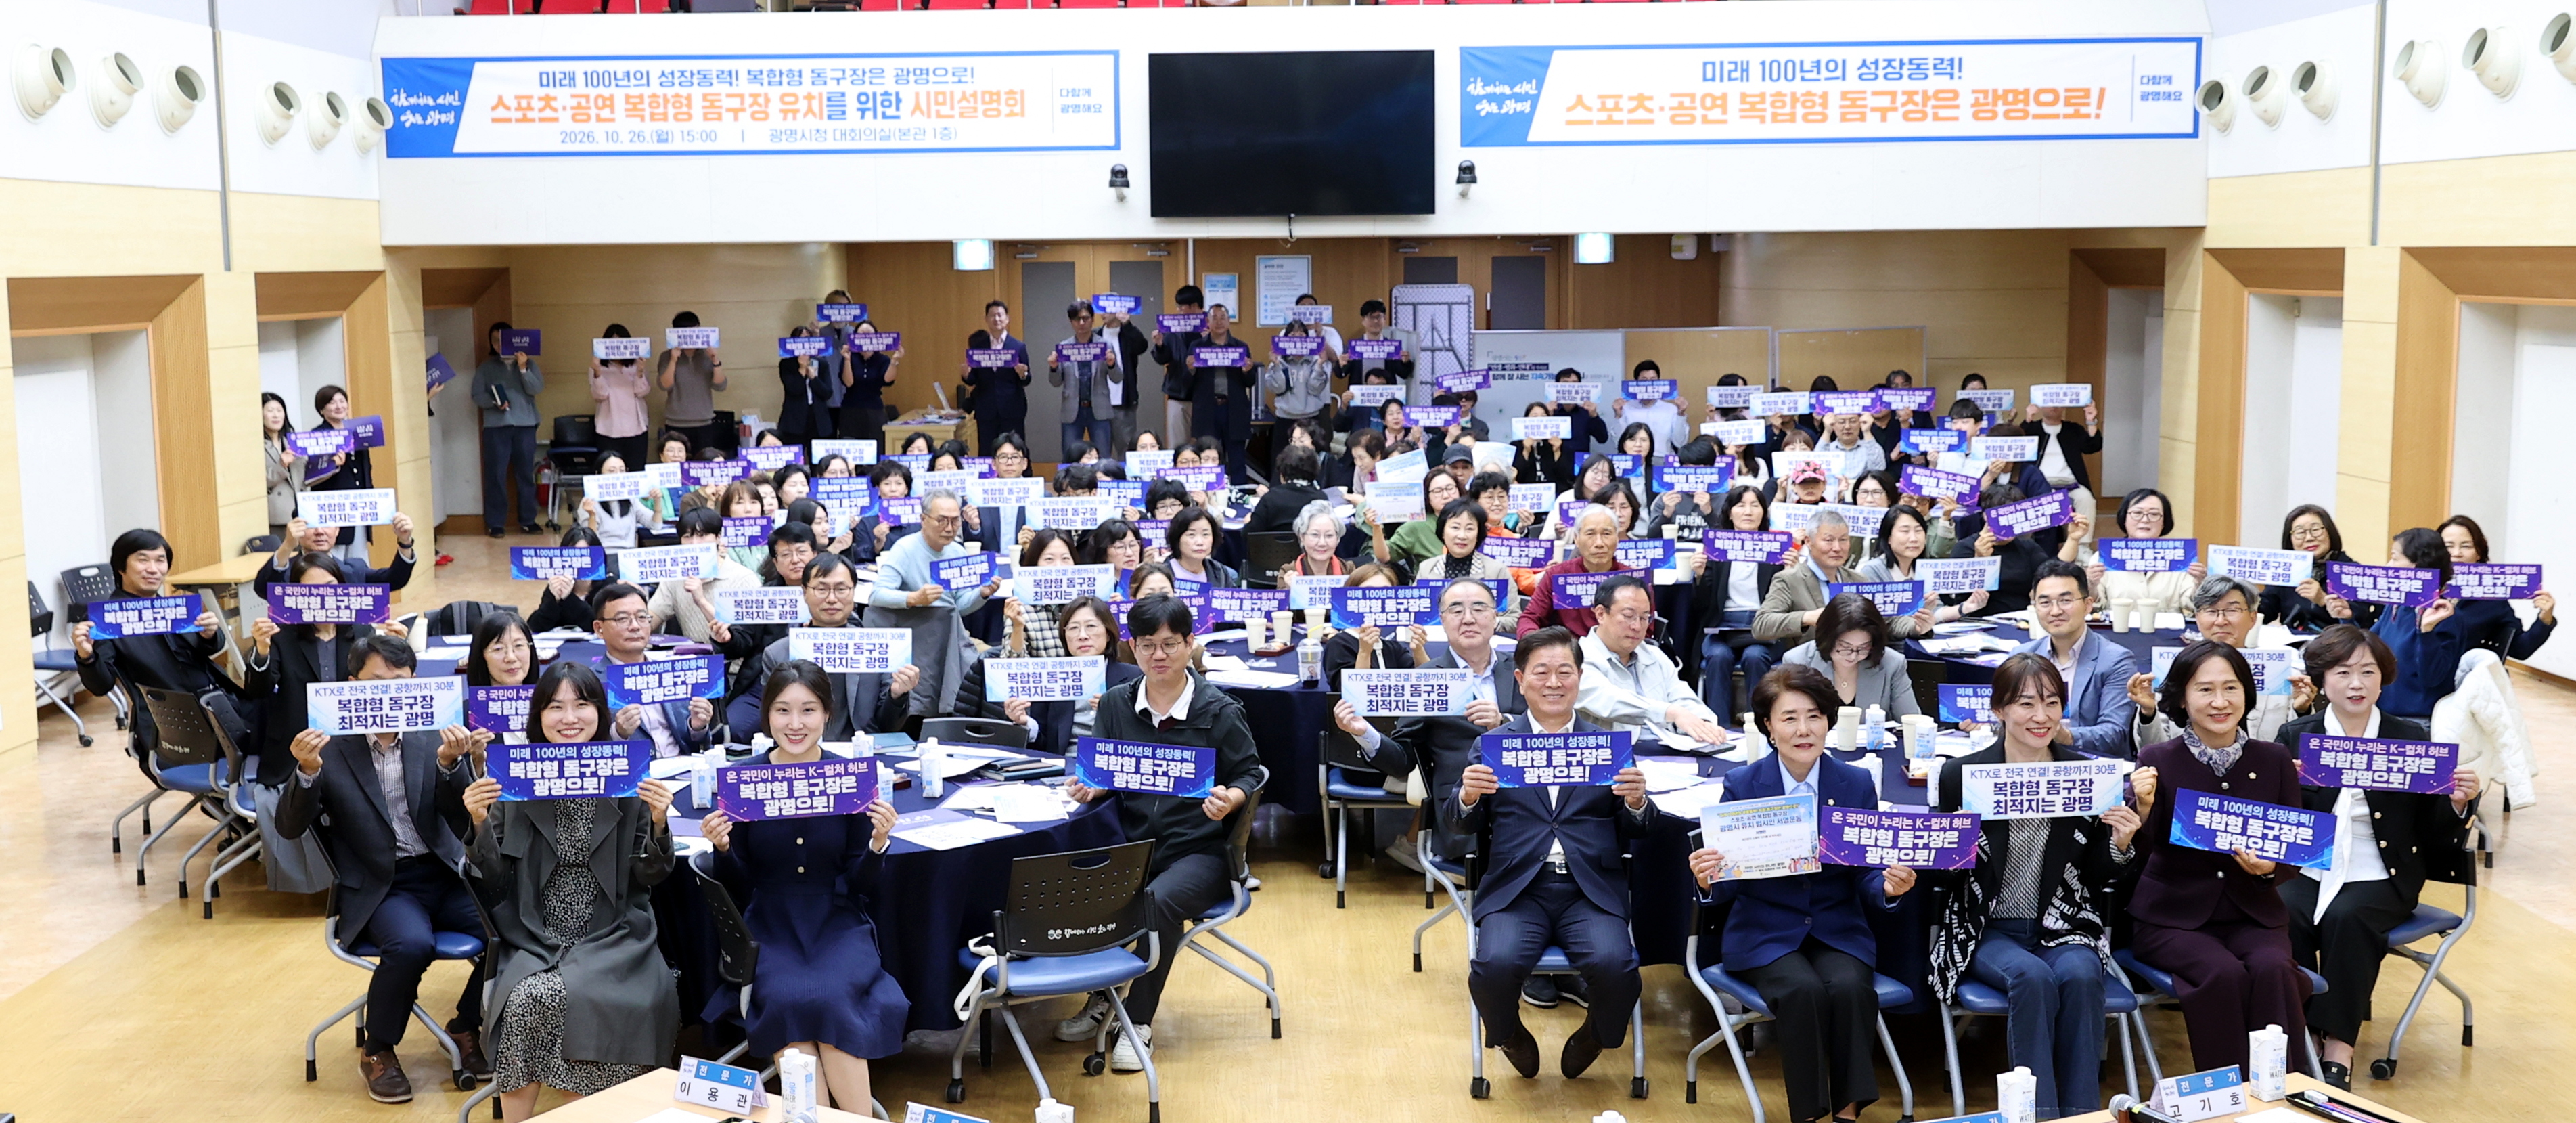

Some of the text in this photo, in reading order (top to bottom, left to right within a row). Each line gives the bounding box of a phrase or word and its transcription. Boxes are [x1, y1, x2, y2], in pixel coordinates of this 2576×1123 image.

[539, 66, 975, 89] 미래 100년의 성장동력! 복합형 돔구장은 광명으로!
[1702, 56, 1962, 83] 미래 100년의 성장동력!
[490, 89, 1025, 123] 스포츠·공연 복합형 돔구장 유치를 위한 시민설명회
[1565, 91, 1728, 125] 스포츠·공연
[1738, 90, 1828, 124] 복합형
[1839, 89, 1960, 123] 돔구장은
[1970, 87, 2106, 121] 광명으로!
[679, 129, 717, 143] 15:00
[769, 127, 828, 143] 광명시청
[284, 596, 374, 609] 복합형 돔구장은
[1347, 598, 1430, 613] 복합형 돔구장은
[302, 609, 356, 622] 광명으로!
[1363, 612, 1414, 625] 광명으로!
[1348, 672, 1467, 682] KTX로 전국 연결! 공항까지 30분
[315, 680, 455, 697] KTX로 전국 연결! 공항까지 30분
[1366, 684, 1449, 697] 복합형 돔구장
[338, 695, 434, 713] 복합형 돔구장
[1366, 699, 1449, 712] 최적지는 광명
[338, 711, 434, 730] 최적지는 광명
[509, 744, 627, 760] 미래 100년의 성장동력!
[1096, 742, 1196, 761] 미래 100년의 성장동력!
[1502, 735, 1611, 749] 미래 100년의 성장동력!
[2309, 737, 2449, 757] 온 국민이 누리는 K-컬처 허브
[1094, 753, 1196, 778] 복합형 돔구장은
[1501, 747, 1612, 767] 복합형 돔구장은
[2320, 750, 2436, 774] 복합형 돔구장은
[509, 757, 629, 779] 복합형 돔구장은
[726, 761, 869, 783] 온 국민이 누리는 K-컬처 허브
[1523, 766, 1590, 784] 광명으로!
[1970, 764, 2117, 779] KTX로 전국 연결! 공항까지 30분
[533, 776, 605, 797] 광명으로!
[739, 775, 857, 800] 복합형 돔구장은
[1113, 772, 1175, 792] 광명으로!
[1993, 778, 2094, 797] 복합형 돔구장
[2341, 769, 2411, 789] 광명으로!
[763, 795, 834, 817] 광명으로!
[1993, 796, 2093, 816] 최적지는 광명
[2198, 796, 2315, 827] 미래 100년의 성장동력!
[1720, 824, 1740, 833] 광명시
[1777, 816, 1802, 824] 서명운동
[1832, 812, 1972, 829] 온 국민이 누리는 K-컬처 허브
[2194, 810, 2314, 845] 복합형 돔구장은
[1843, 826, 1959, 848] 복합형 돔구장은
[2215, 831, 2287, 859] 광명으로!
[1865, 846, 1936, 866] 광명으로!
